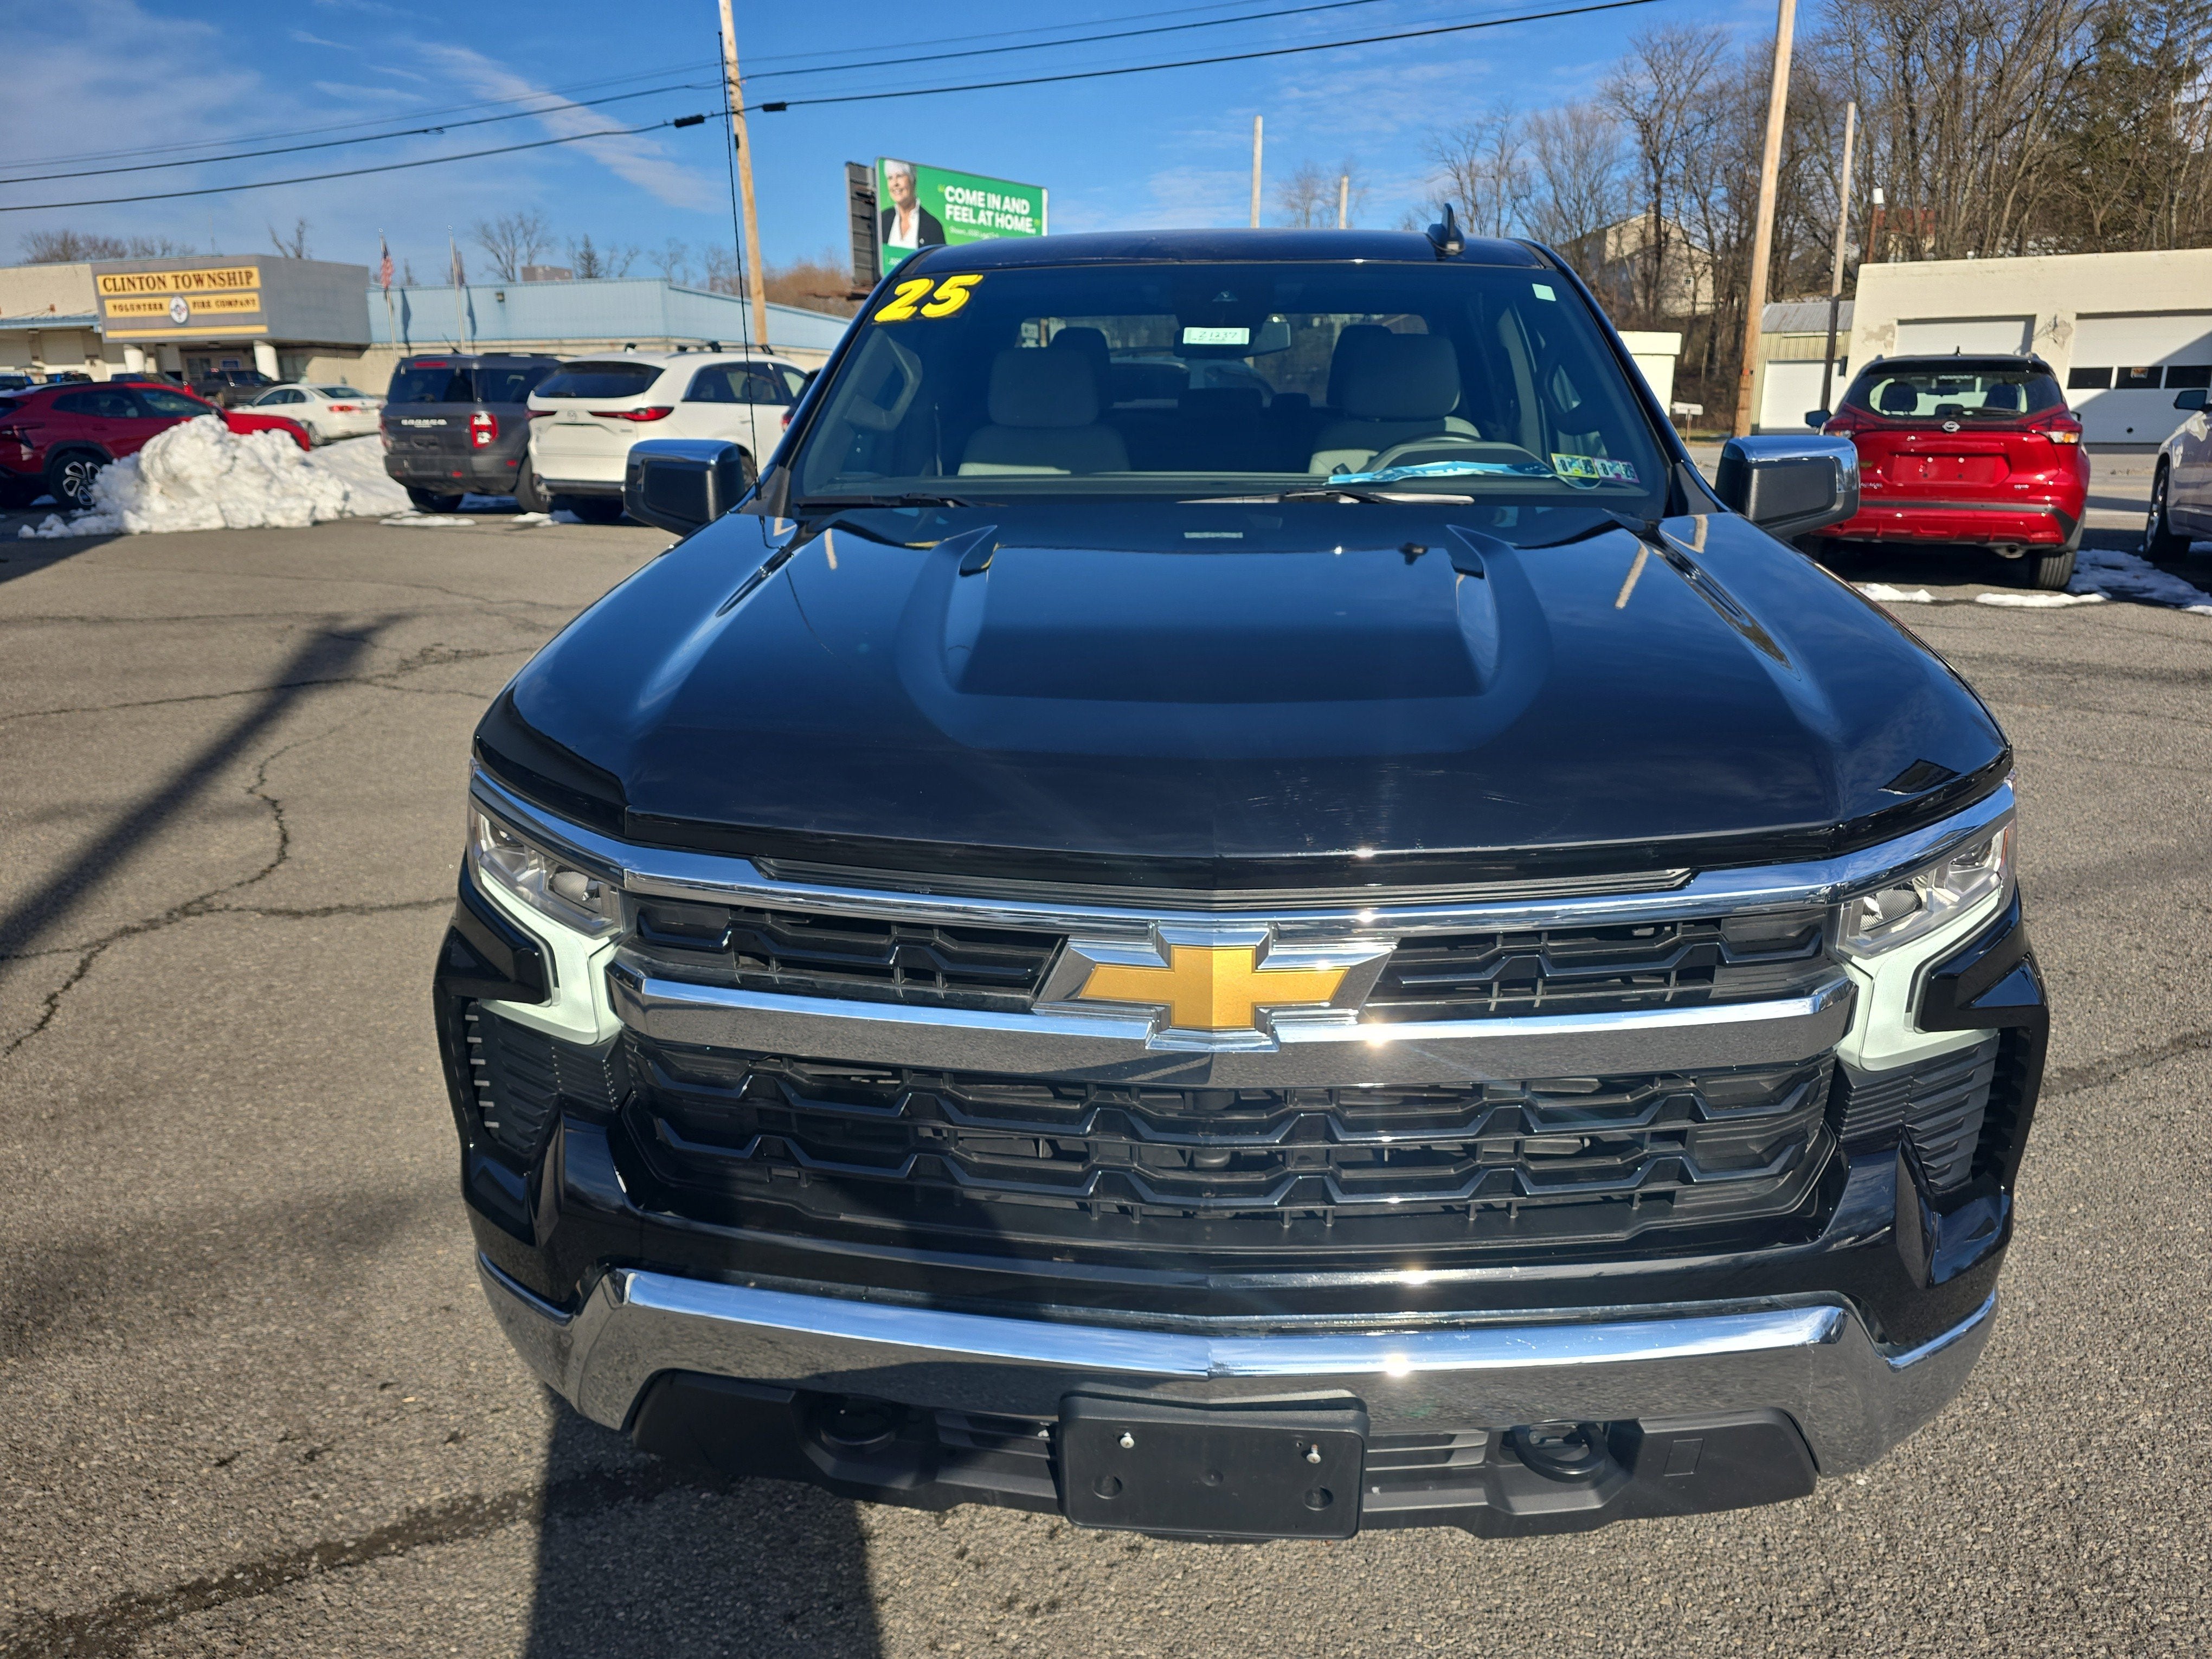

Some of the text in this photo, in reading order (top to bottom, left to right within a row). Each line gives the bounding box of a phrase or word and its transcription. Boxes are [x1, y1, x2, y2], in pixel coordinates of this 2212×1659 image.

[987, 192, 1001, 210] IN
[1002, 196, 1031, 215] AND
[945, 203, 977, 224] FEEL
[978, 209, 994, 228] AT
[102, 269, 254, 292] CLINTON TOWNSHIP
[112, 298, 256, 312] VOLUNTEER FIRE COMPANY
[874, 274, 984, 323] 25
